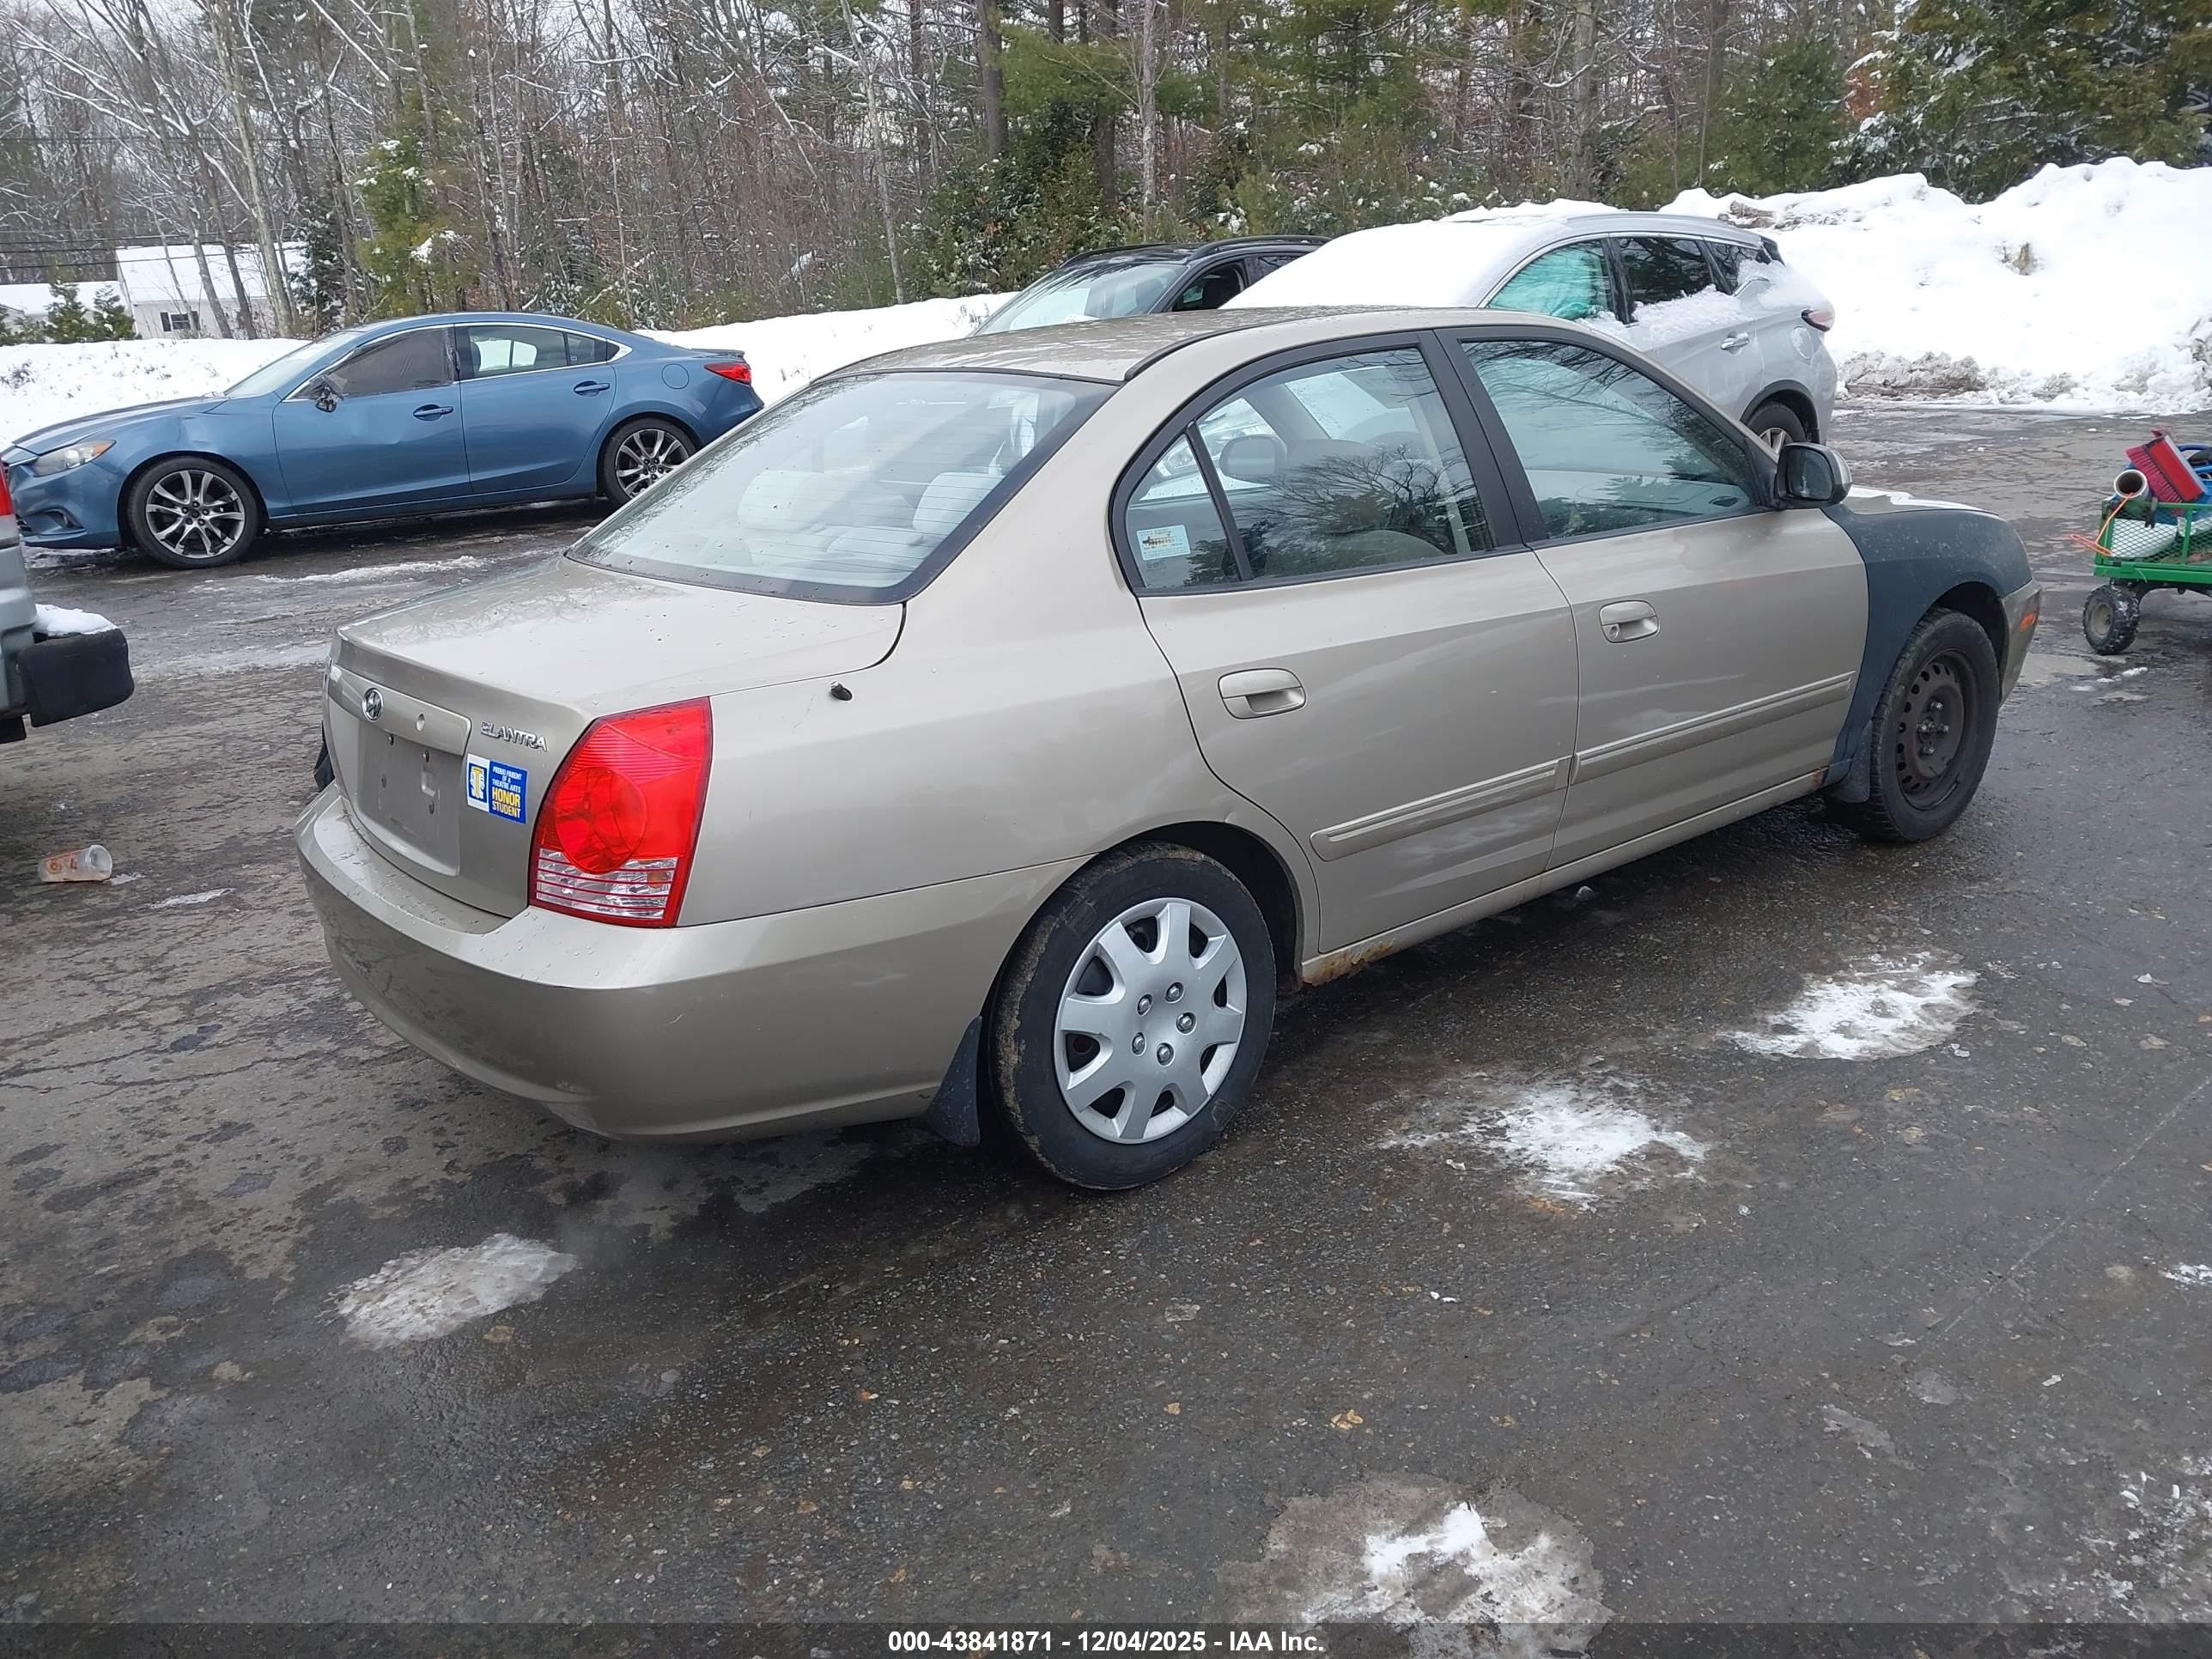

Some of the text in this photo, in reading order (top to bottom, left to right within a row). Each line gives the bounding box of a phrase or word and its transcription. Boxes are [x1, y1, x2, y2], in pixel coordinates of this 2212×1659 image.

[481, 721, 548, 752] ELANTRA
[492, 766, 522, 781] PROUD PARENT
[492, 778, 521, 793] THEATRE ARTS
[492, 786, 520, 808] HONOR
[492, 800, 521, 818] STUDENT
